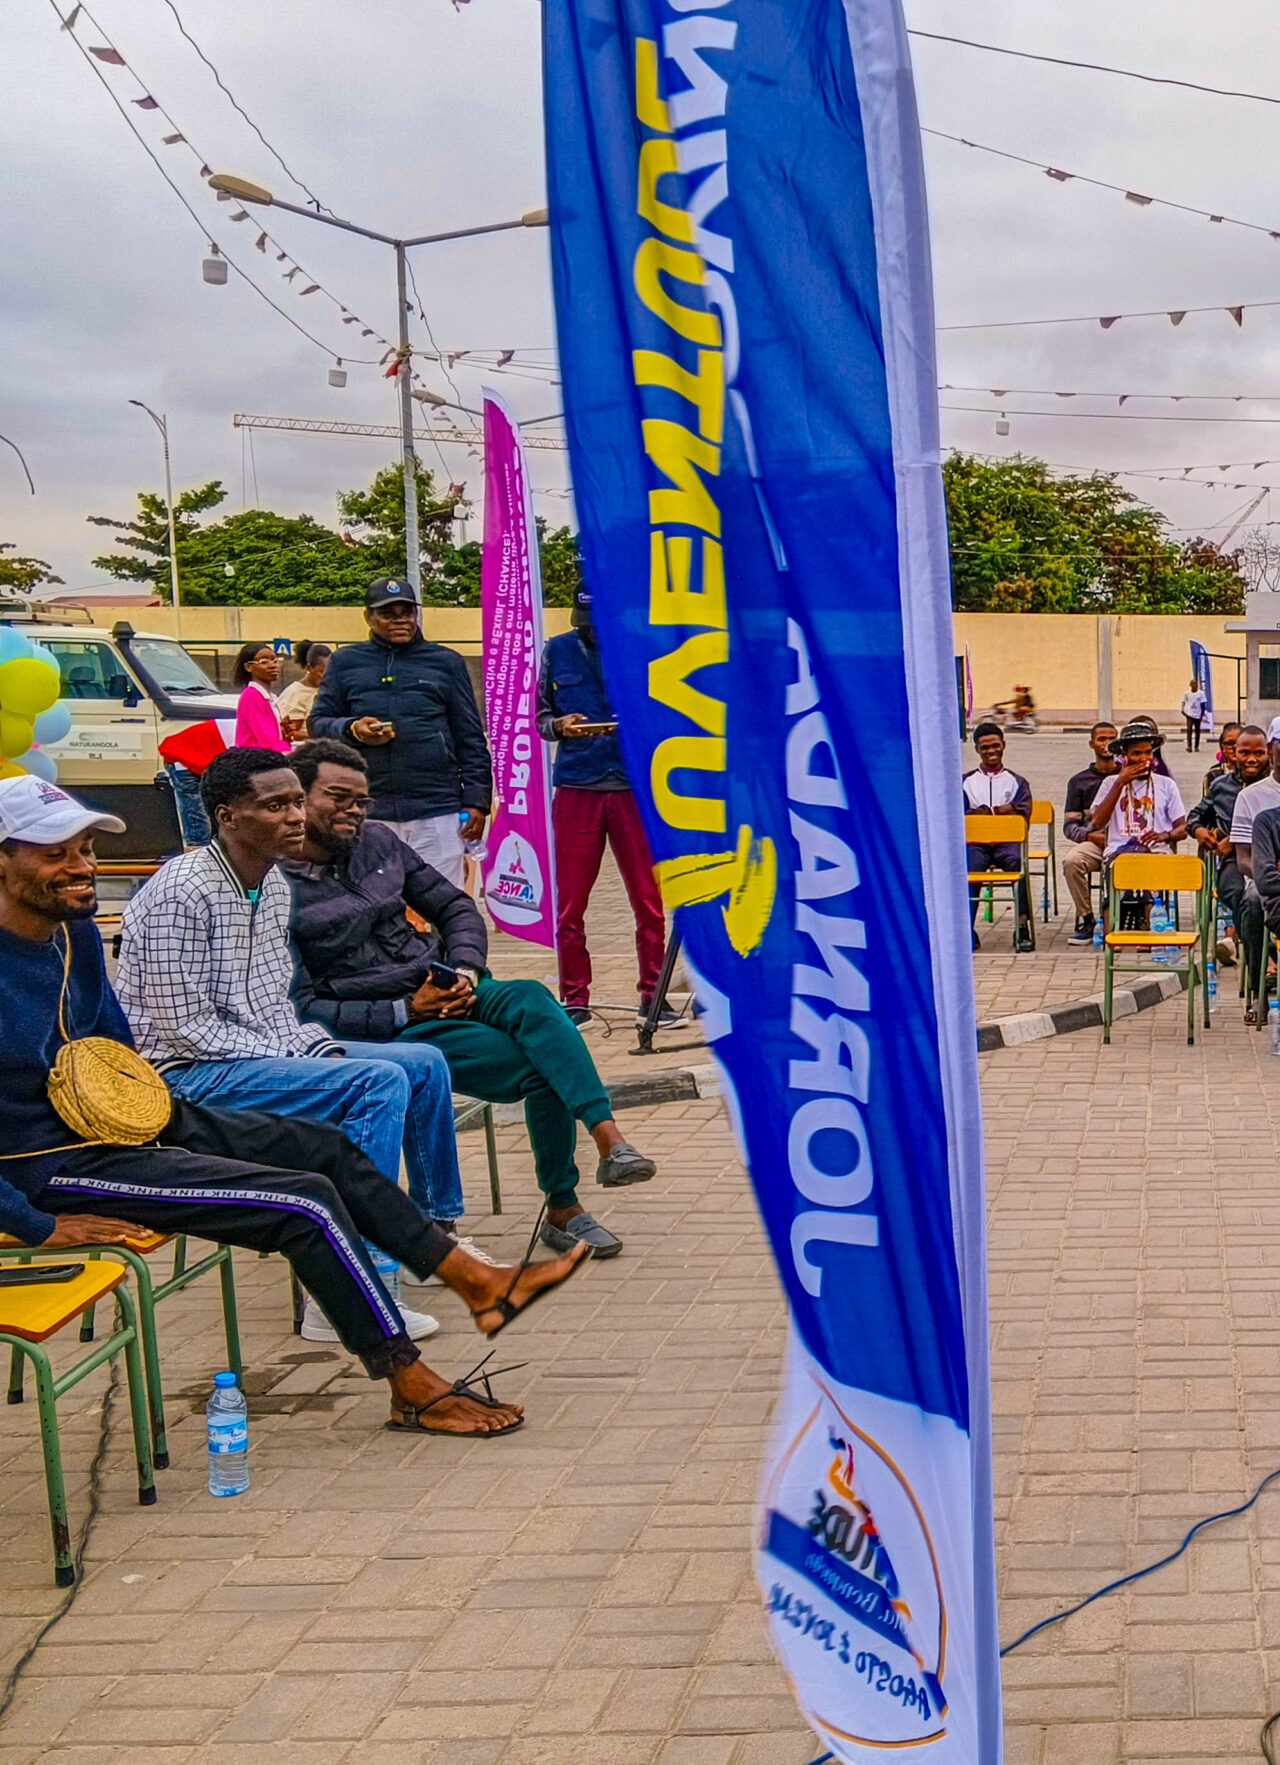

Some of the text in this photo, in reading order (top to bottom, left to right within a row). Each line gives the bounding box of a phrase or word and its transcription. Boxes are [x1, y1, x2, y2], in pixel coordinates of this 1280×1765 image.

[54, 1178, 80, 1186] PIN
[88, 1180, 121, 1191] PINK
[127, 1186, 163, 1196] PINK
[169, 1189, 205, 1198] PINK
[212, 1190, 248, 1199] PINK
[254, 1191, 289, 1202] PINK
